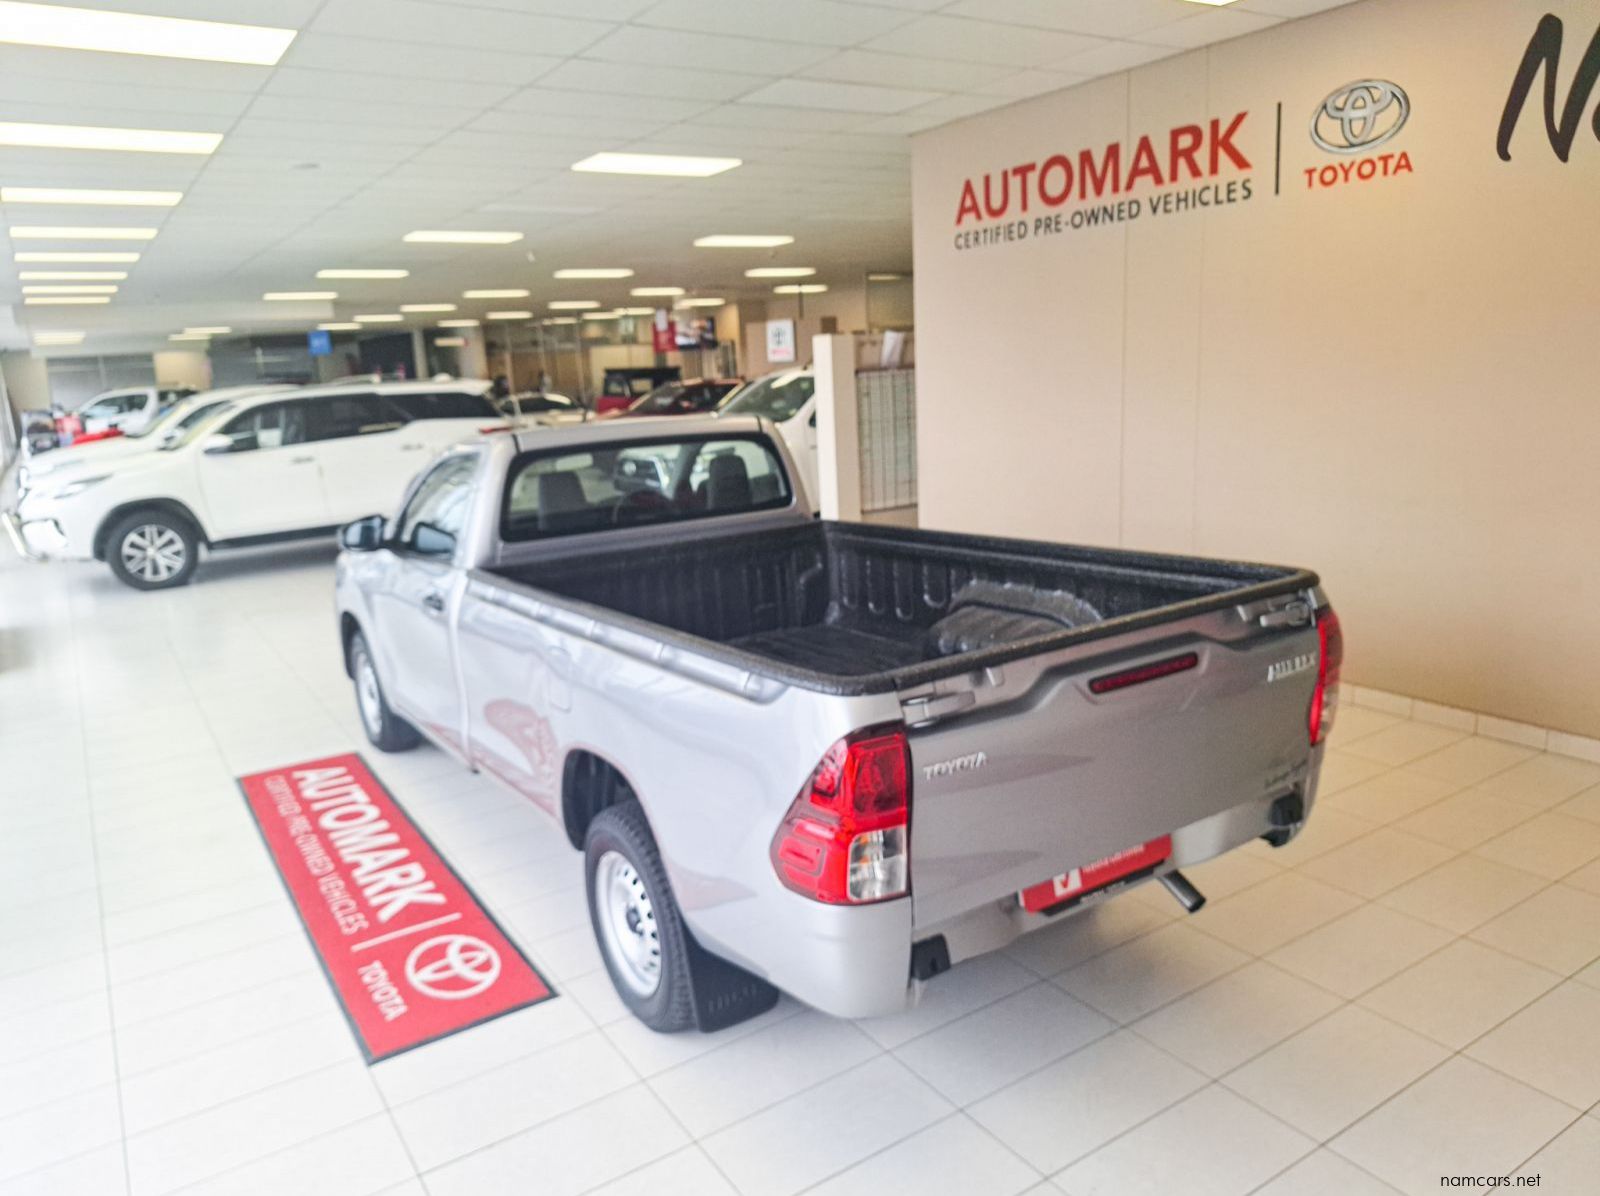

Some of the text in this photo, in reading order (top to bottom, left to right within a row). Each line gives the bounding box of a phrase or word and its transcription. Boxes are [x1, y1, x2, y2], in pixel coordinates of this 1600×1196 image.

[1497, 13, 1600, 163] N
[955, 111, 1252, 226] AUTOMARK
[1304, 151, 1413, 188] TOYOTA
[955, 178, 1253, 250] CERTIFIED PRE-OWNED VEHICLES
[923, 751, 986, 780] TOYOTA
[292, 766, 446, 923] AUTOMARK
[318, 872, 369, 935] VEHICLES
[358, 960, 408, 1021] TOYOTA
